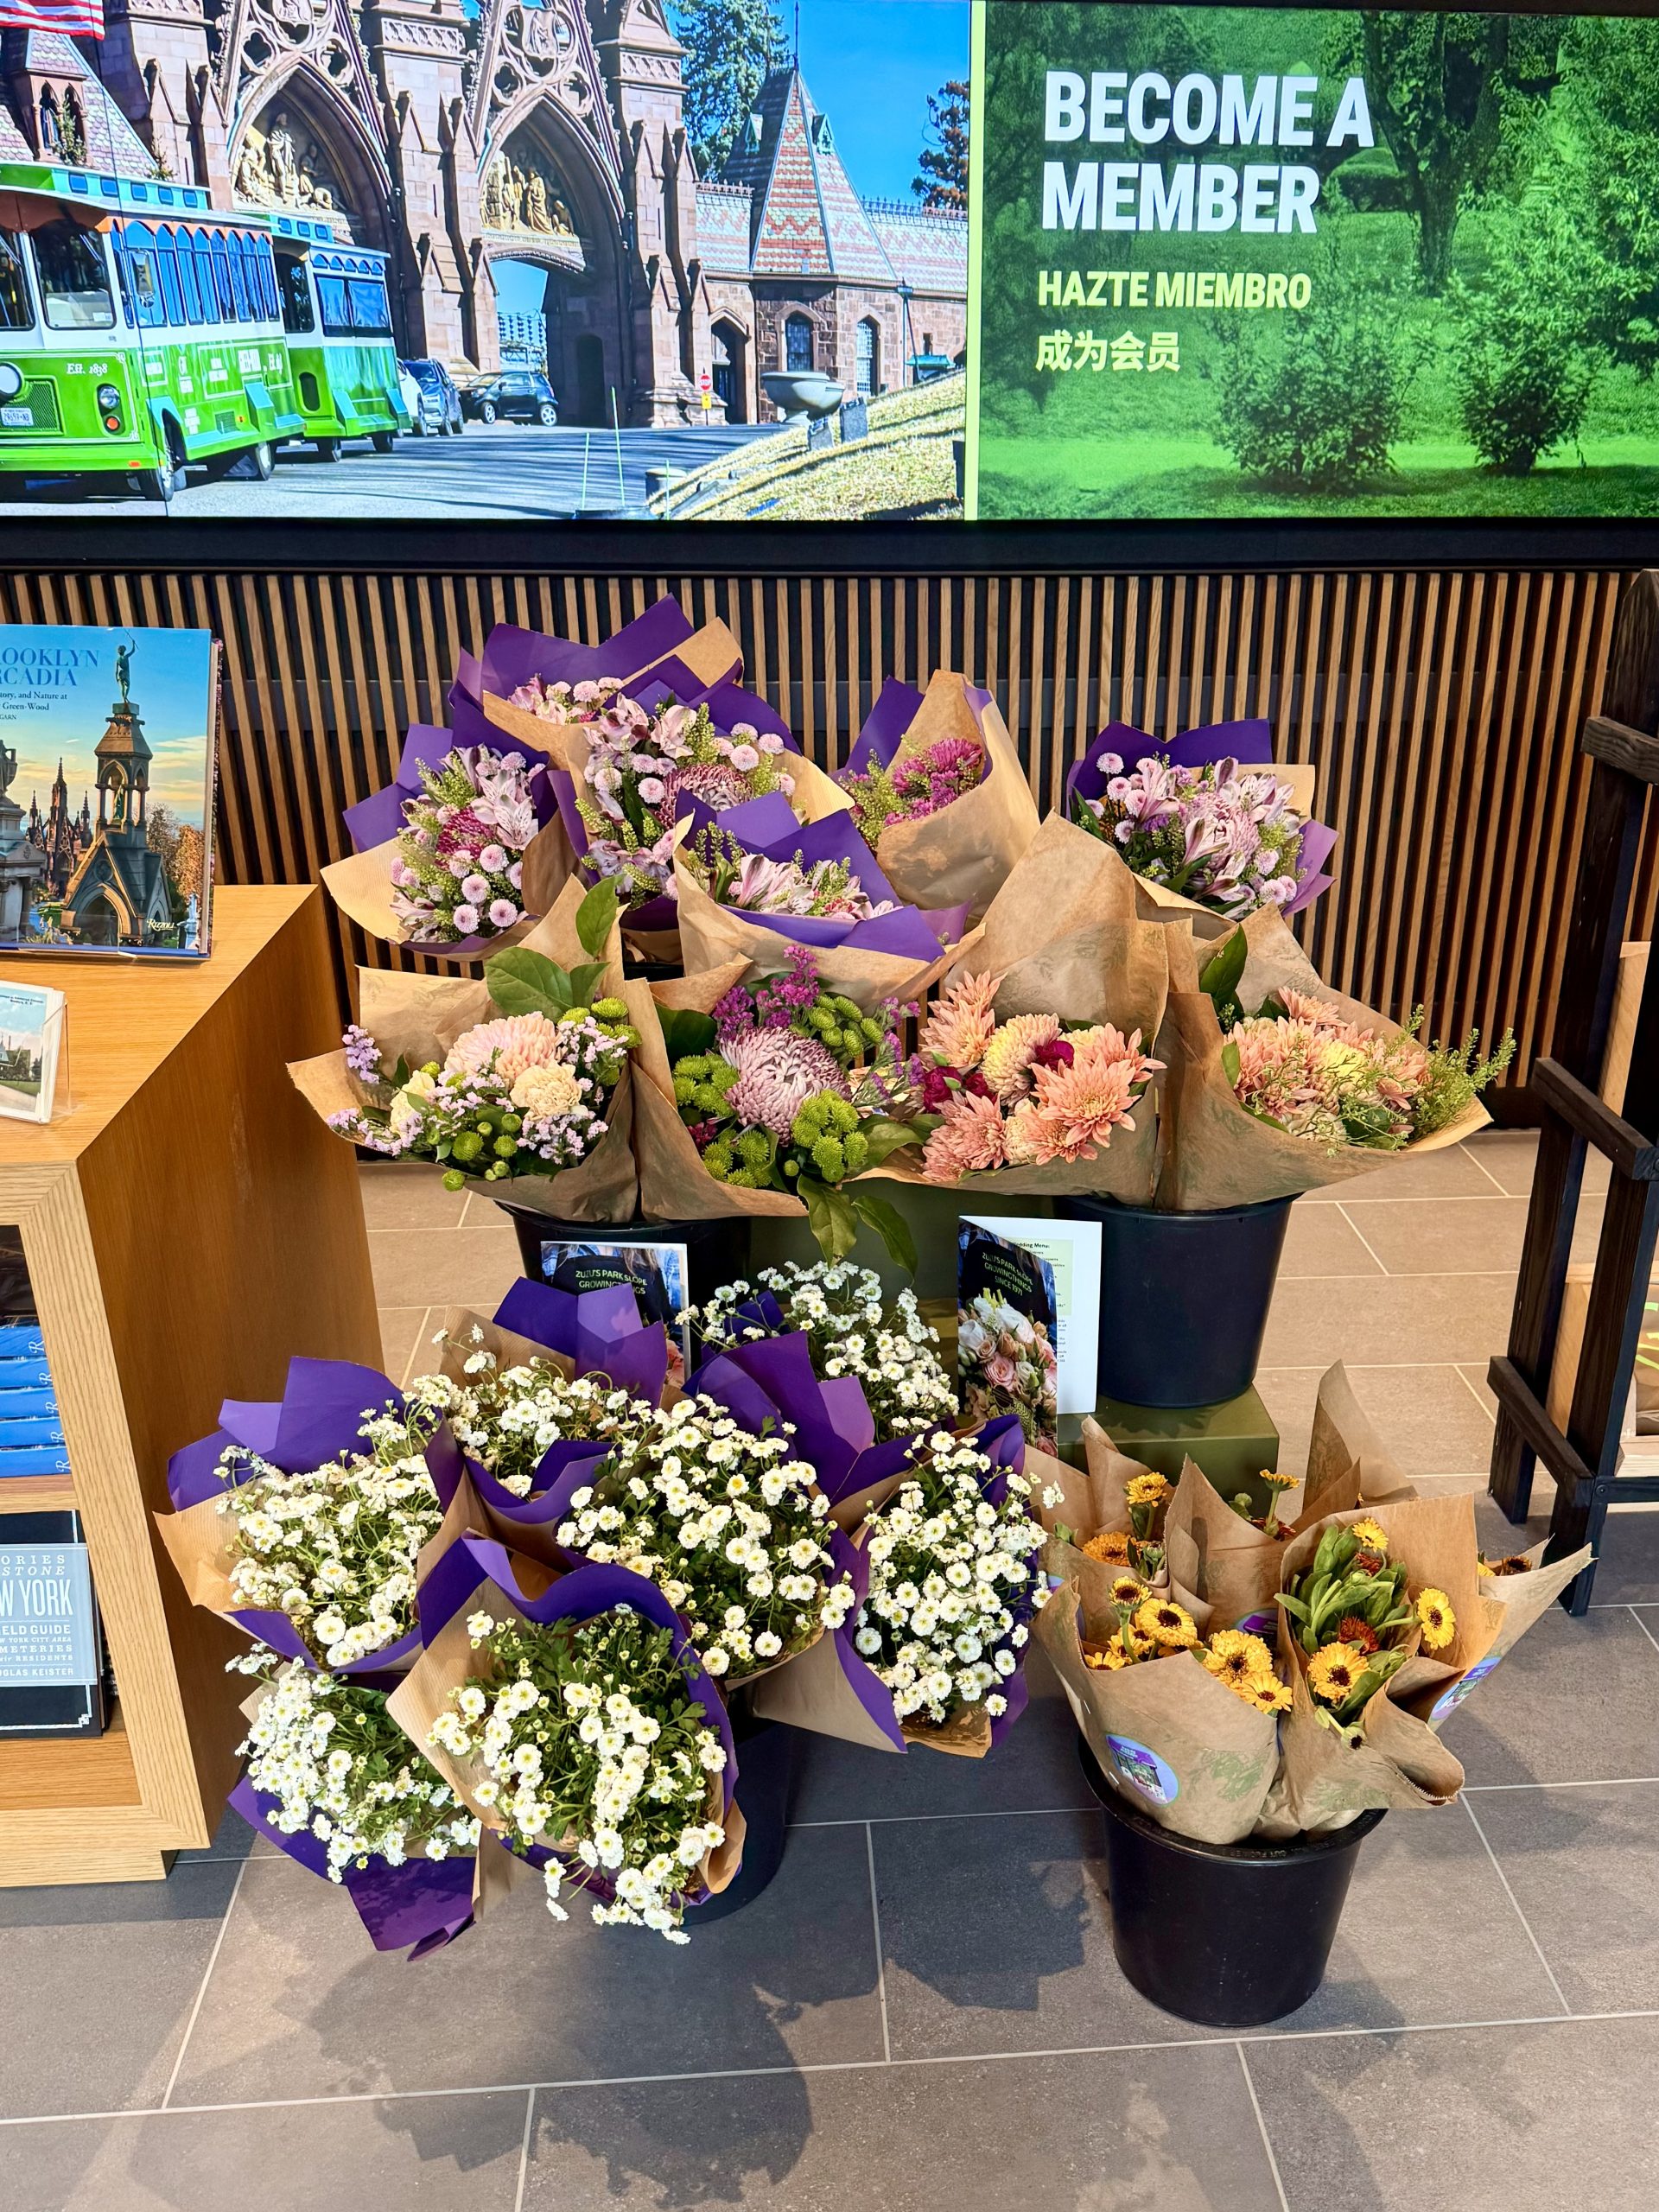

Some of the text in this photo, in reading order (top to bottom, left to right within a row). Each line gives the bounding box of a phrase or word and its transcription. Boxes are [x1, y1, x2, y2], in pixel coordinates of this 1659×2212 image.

[1044, 70, 1375, 148] BECOME A
[1042, 161, 1320, 233] MEMBER
[1038, 270, 1313, 308] HAZTE MIEMBRO
[1035, 329, 1181, 372] 成为会员
[89, 363, 108, 377] 1838
[0, 647, 100, 667] OOKLYN
[0, 667, 77, 686] CADIA
[34, 691, 60, 700] Nature
[602, 1270, 624, 1281] PARK
[624, 1274, 648, 1286] SLOPE
[2, 1565, 66, 1576] STONE
[18, 1579, 73, 1617] YORK
[0, 1624, 71, 1636] ELD GUIDE
[32, 1668, 73, 1676] KEISTER
